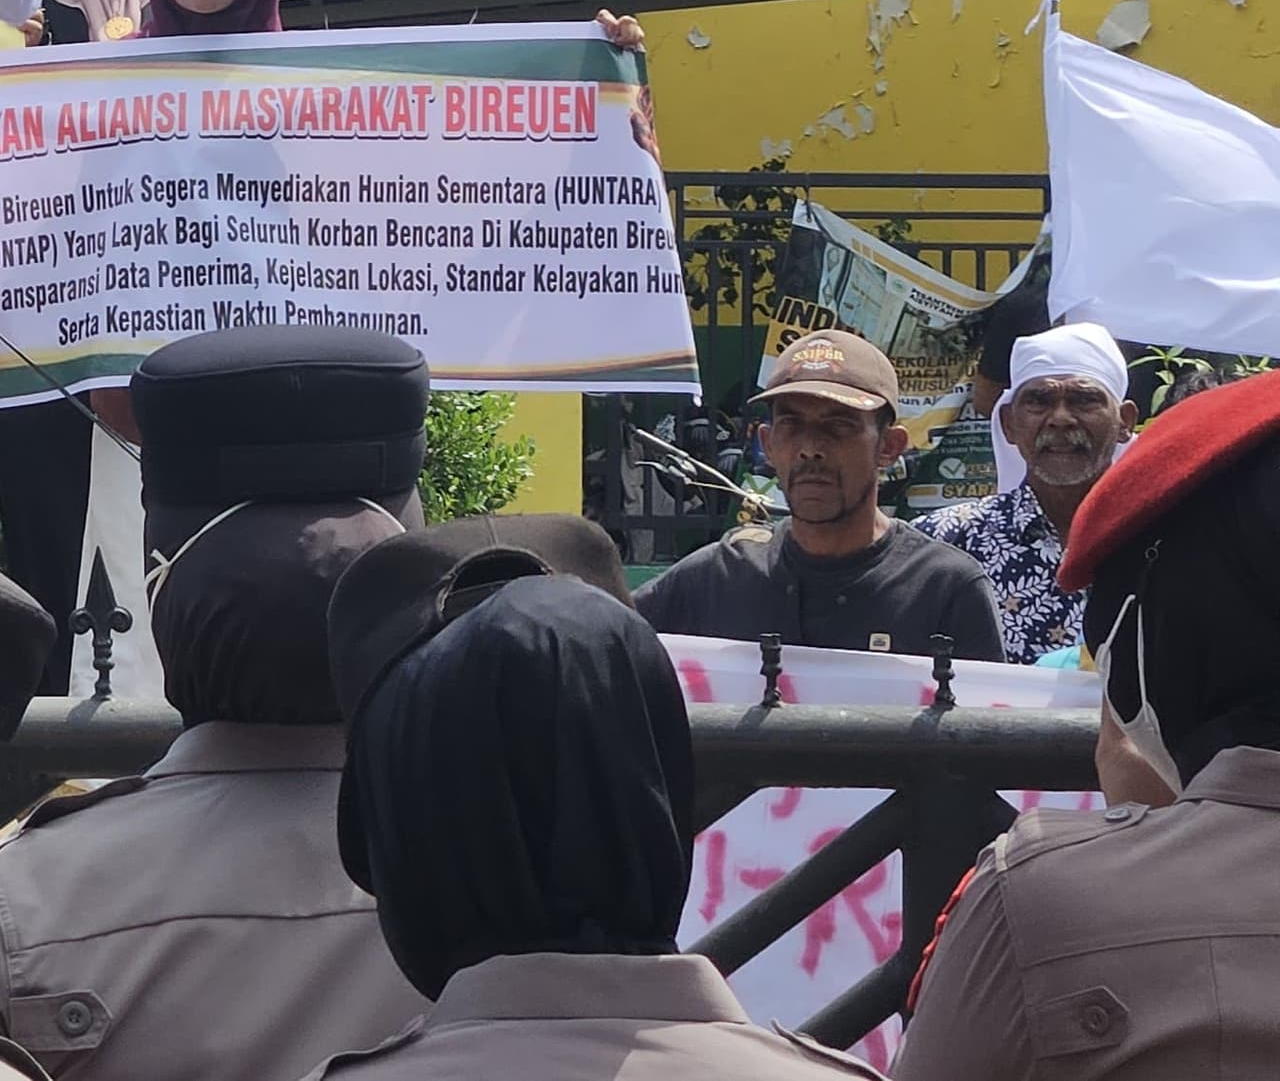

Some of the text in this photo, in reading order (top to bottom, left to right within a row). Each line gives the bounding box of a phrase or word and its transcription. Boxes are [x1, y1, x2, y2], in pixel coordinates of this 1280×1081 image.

[56, 91, 187, 150] ALIANSI
[201, 85, 433, 137] MASYARAKAT
[444, 84, 598, 137] BIREUEN
[3, 191, 76, 224] Bireuen
[82, 178, 135, 213] Untuk
[141, 175, 209, 208] Segera
[216, 173, 351, 208] Menyediakan
[359, 175, 429, 204] Hunian
[437, 175, 546, 205] Sementara
[554, 176, 662, 213] (HUNTARA)
[65, 230, 106, 263] Yang
[112, 220, 168, 252] Layak
[176, 216, 219, 247] Bagi
[227, 217, 301, 247] Seluruh
[308, 218, 379, 248] Korban
[386, 219, 474, 249] Bencana
[482, 220, 502, 249] Di
[509, 220, 618, 257] Kabupaten
[105, 262, 149, 293] Data
[158, 258, 260, 292] Penerima,
[267, 258, 359, 293] Kejelasan
[368, 261, 439, 297] Lokasi,
[446, 263, 526, 293] Standar
[533, 264, 639, 299] Kelayakan
[58, 313, 99, 346] Serta
[106, 303, 206, 340] Kepastian
[213, 300, 276, 331] Waktu
